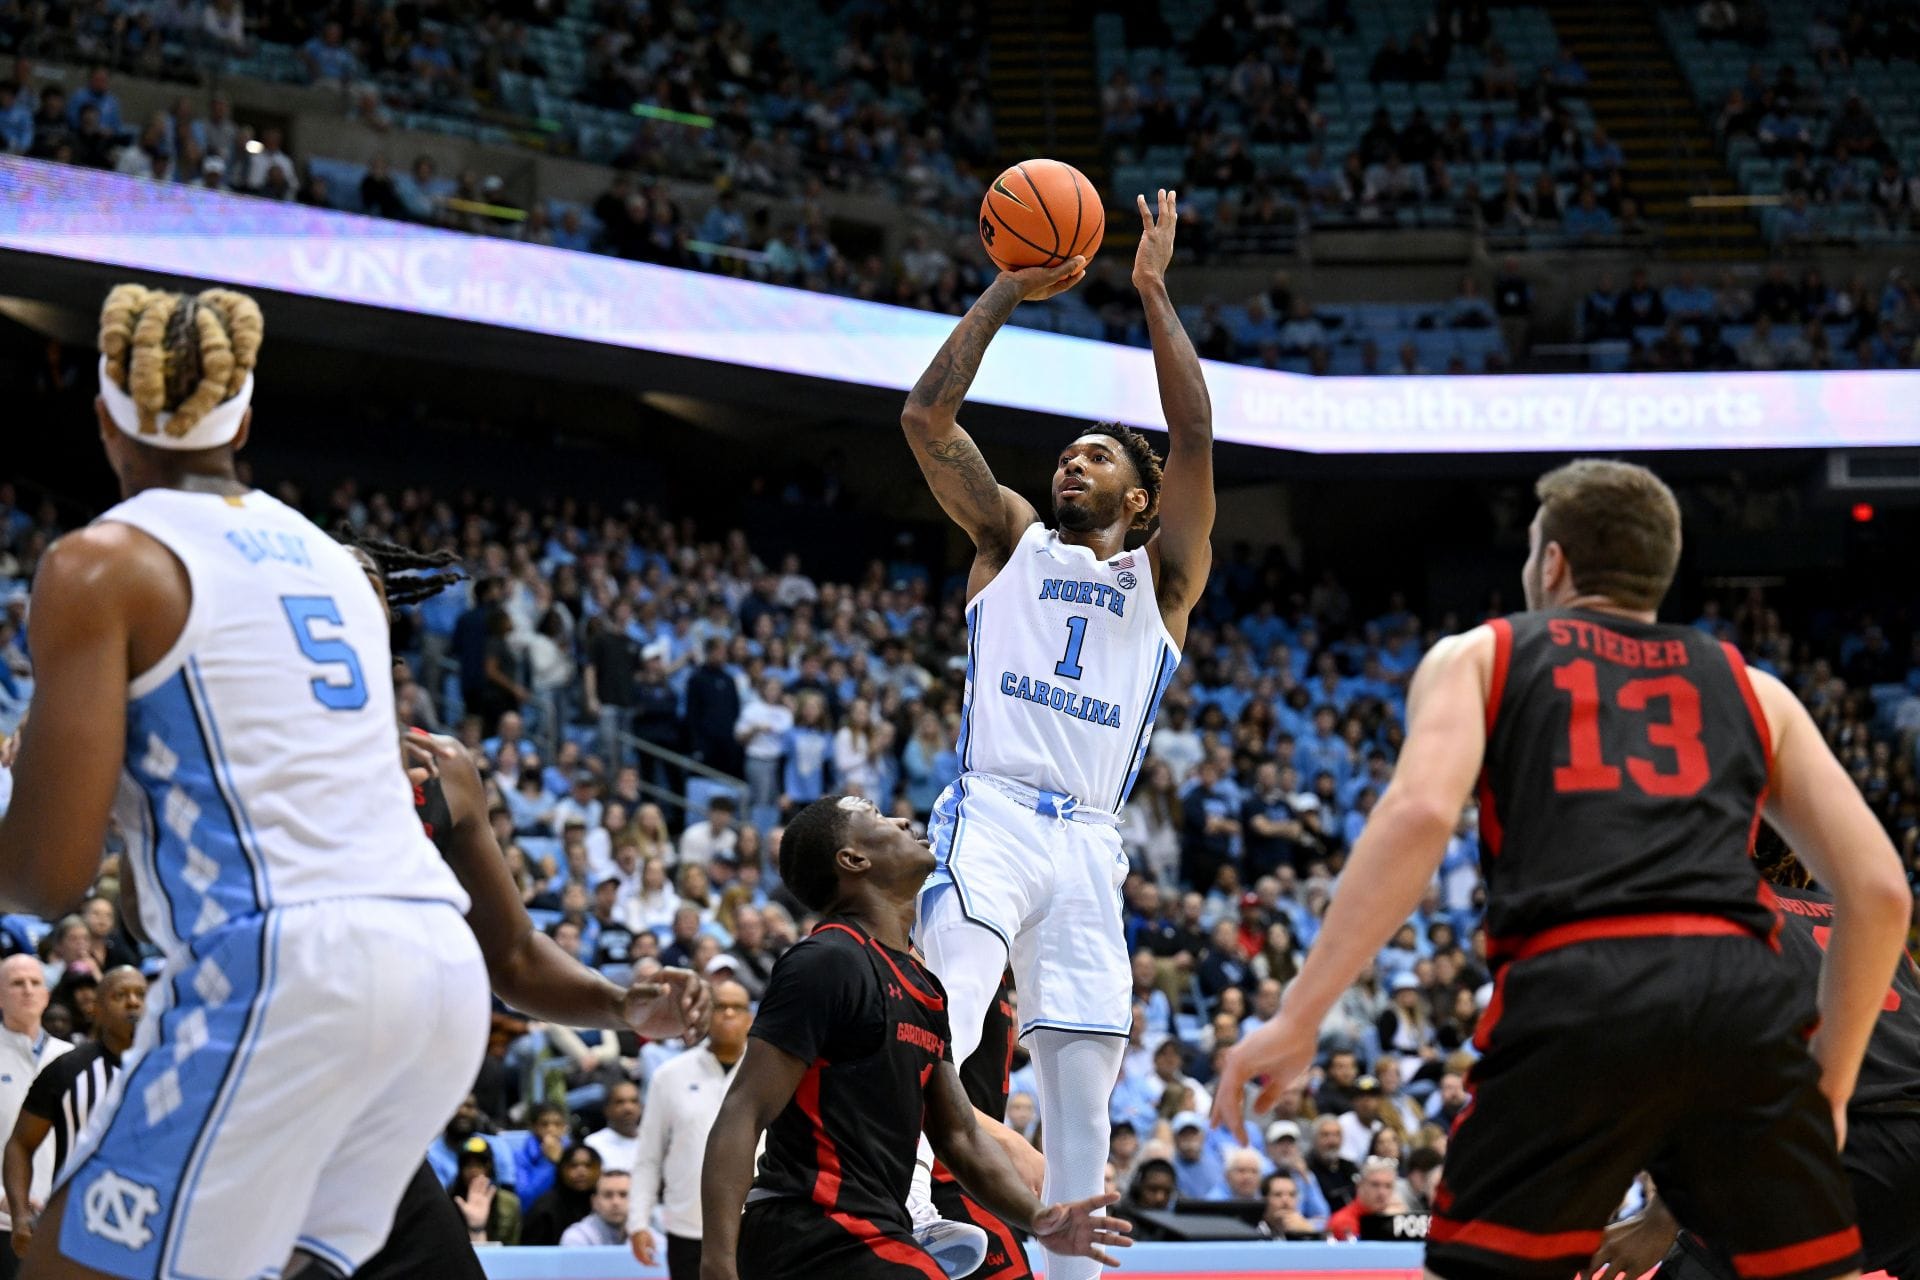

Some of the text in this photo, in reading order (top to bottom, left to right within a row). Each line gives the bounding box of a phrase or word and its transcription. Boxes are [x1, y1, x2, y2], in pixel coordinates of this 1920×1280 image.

[291, 243, 612, 328] UNC HEALTH
[1242, 382, 1764, 438] unchealth.org/sports
[1039, 578, 1126, 618] NORTH
[279, 594, 369, 711] 5
[1054, 615, 1089, 681] 1
[1548, 618, 1690, 669] STIEBER
[1000, 671, 1121, 729] CAROLINA
[1552, 657, 1712, 797] 13
[1393, 1214, 1432, 1238] POS
